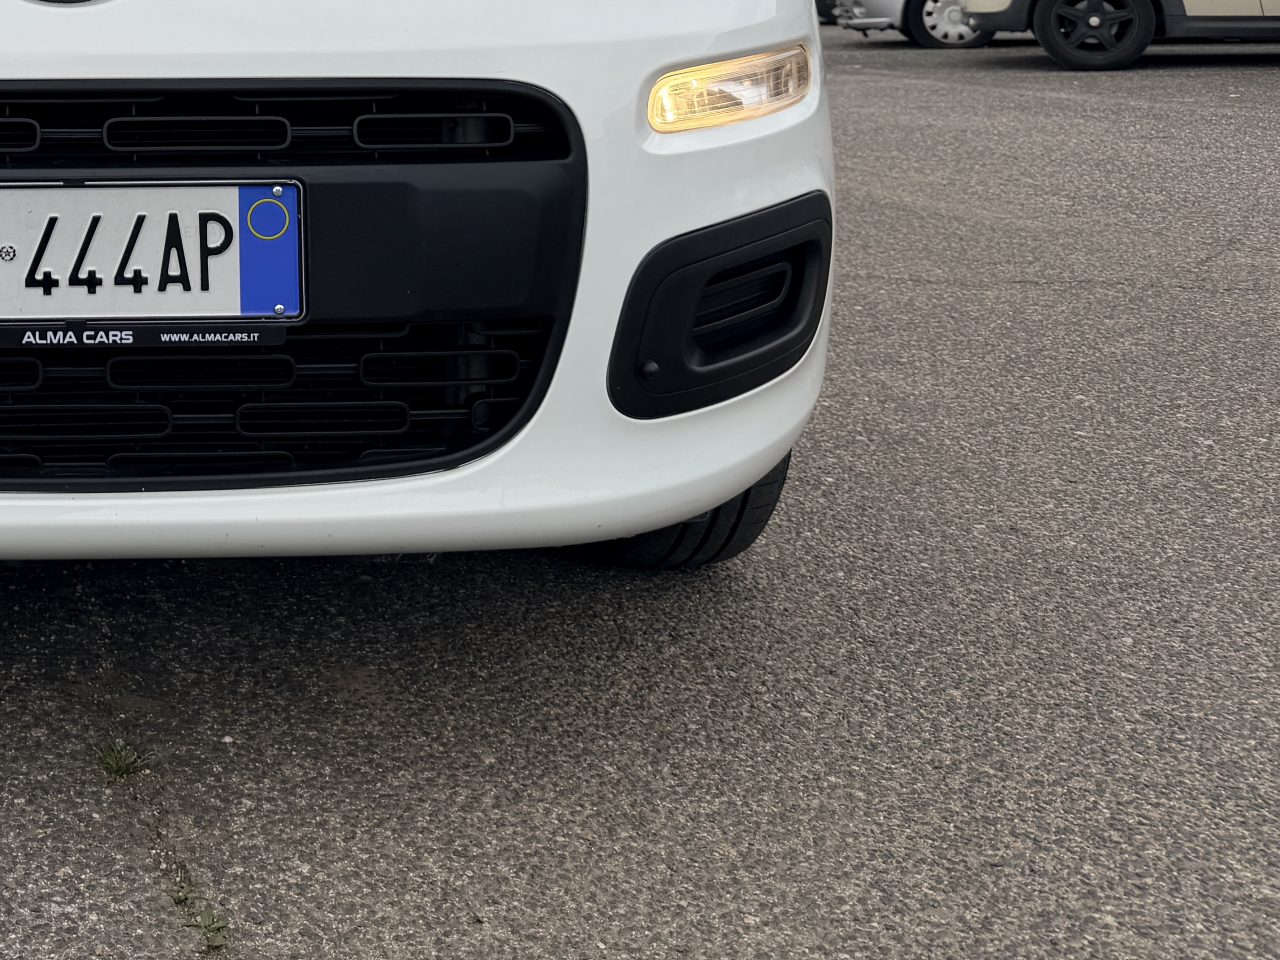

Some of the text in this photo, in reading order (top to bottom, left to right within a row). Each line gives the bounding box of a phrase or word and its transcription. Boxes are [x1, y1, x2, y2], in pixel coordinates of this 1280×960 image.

[24, 211, 234, 296] 444AP
[21, 330, 134, 344] ALMA CARS
[160, 333, 260, 342] WWW.ALMACARS.IT
